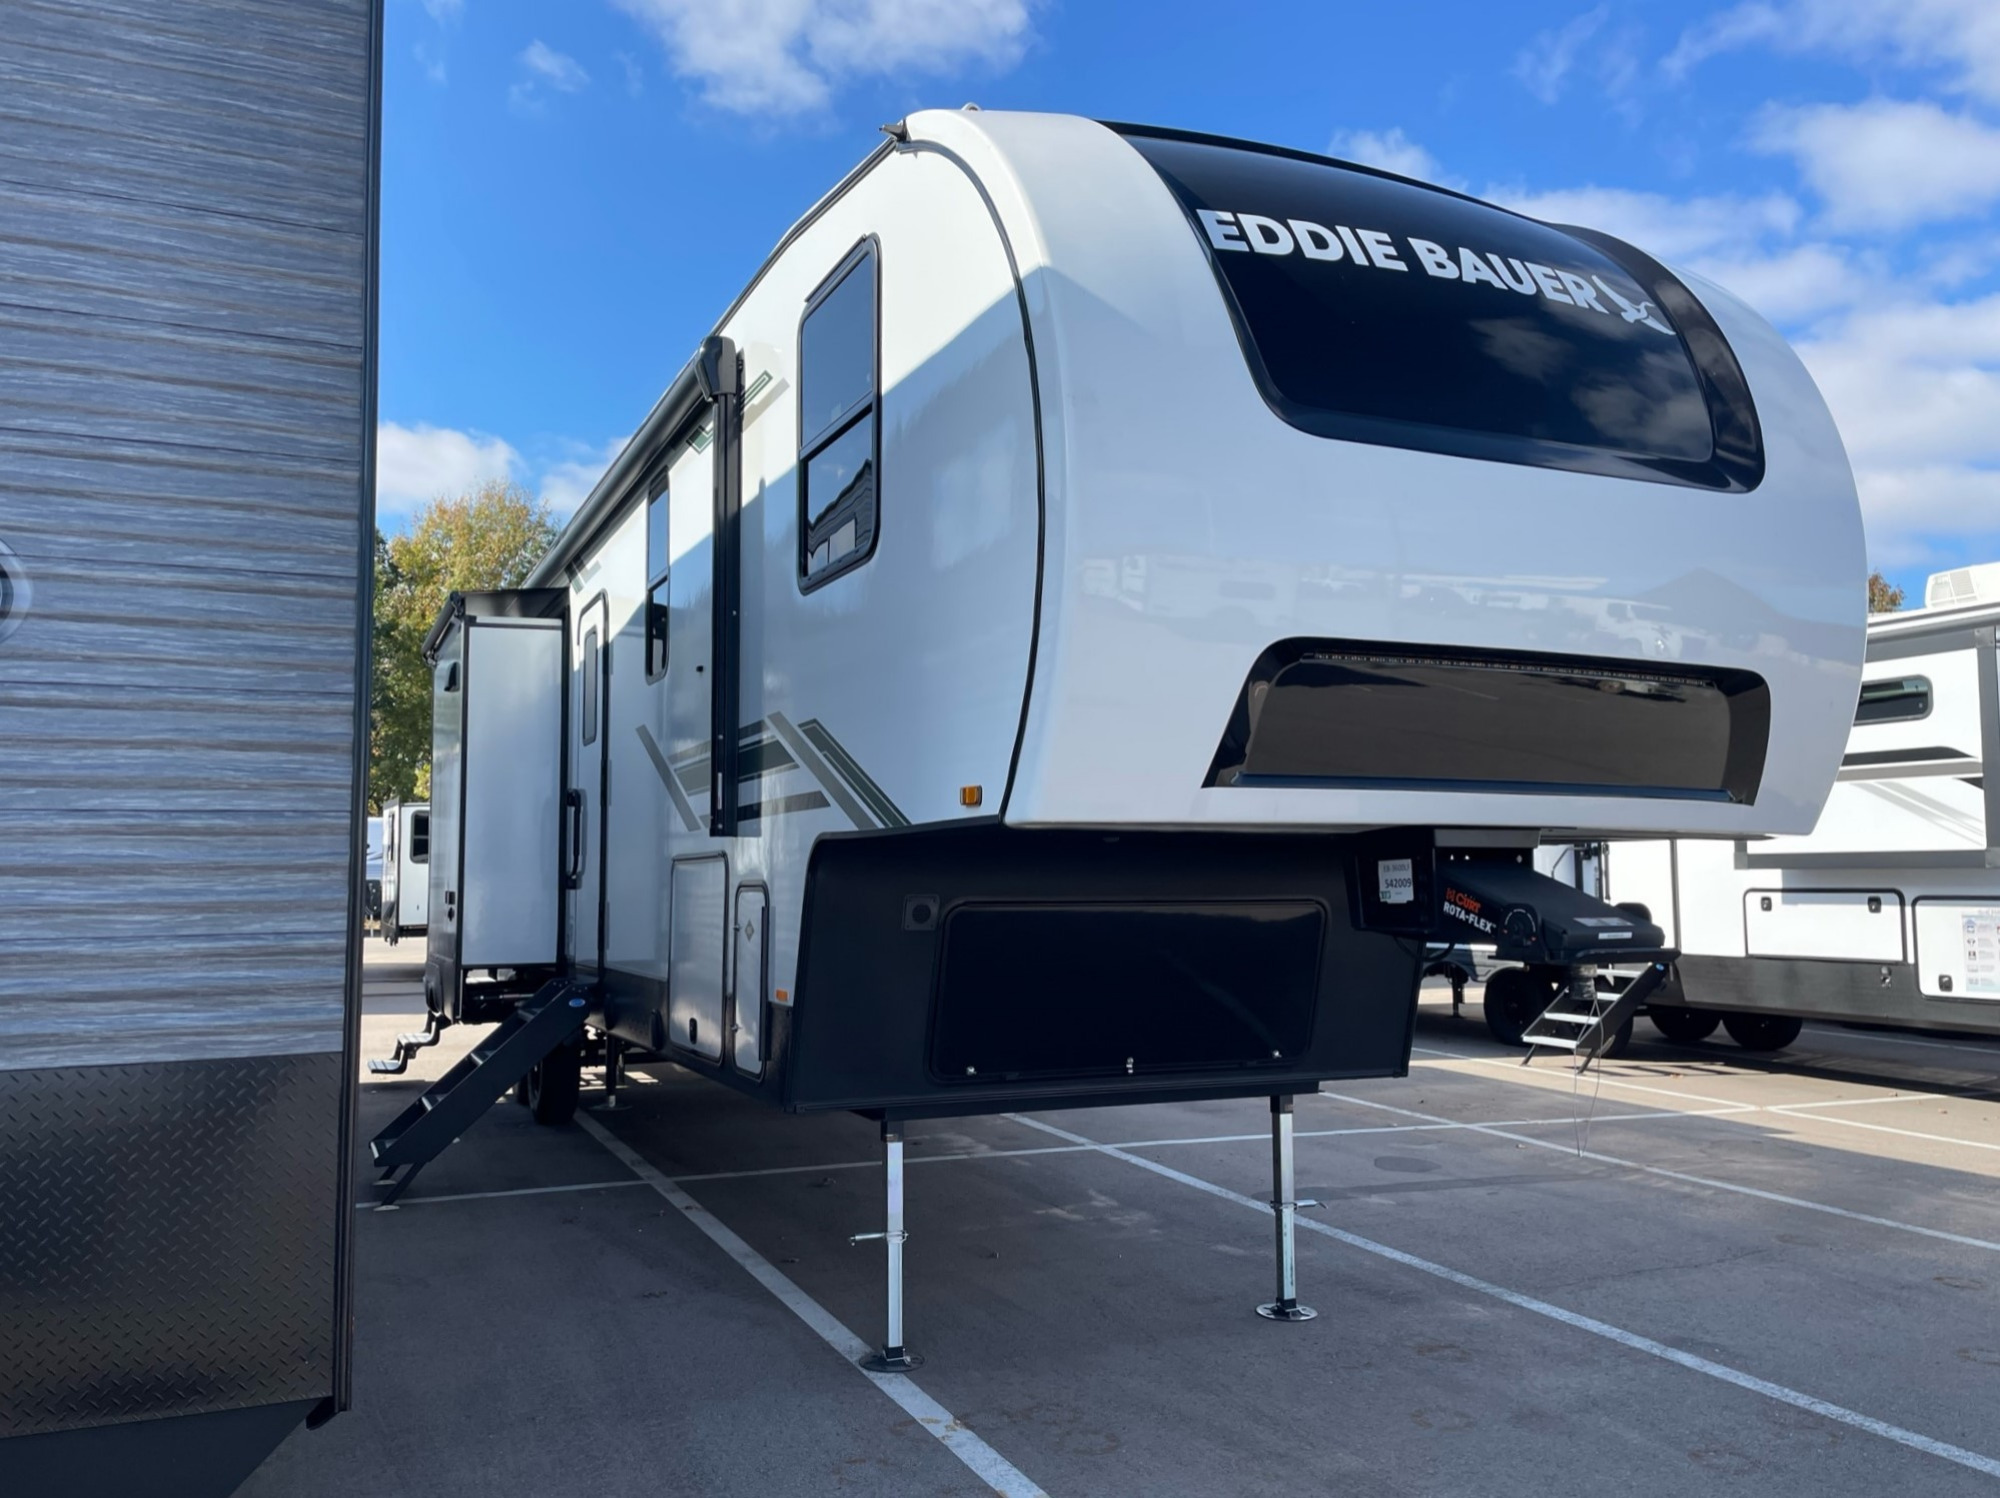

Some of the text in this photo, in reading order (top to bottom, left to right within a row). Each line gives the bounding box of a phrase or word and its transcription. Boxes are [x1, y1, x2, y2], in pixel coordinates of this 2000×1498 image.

[1196, 209, 1610, 314] EDDIE BAUER
[1385, 878, 1412, 889] 542009
